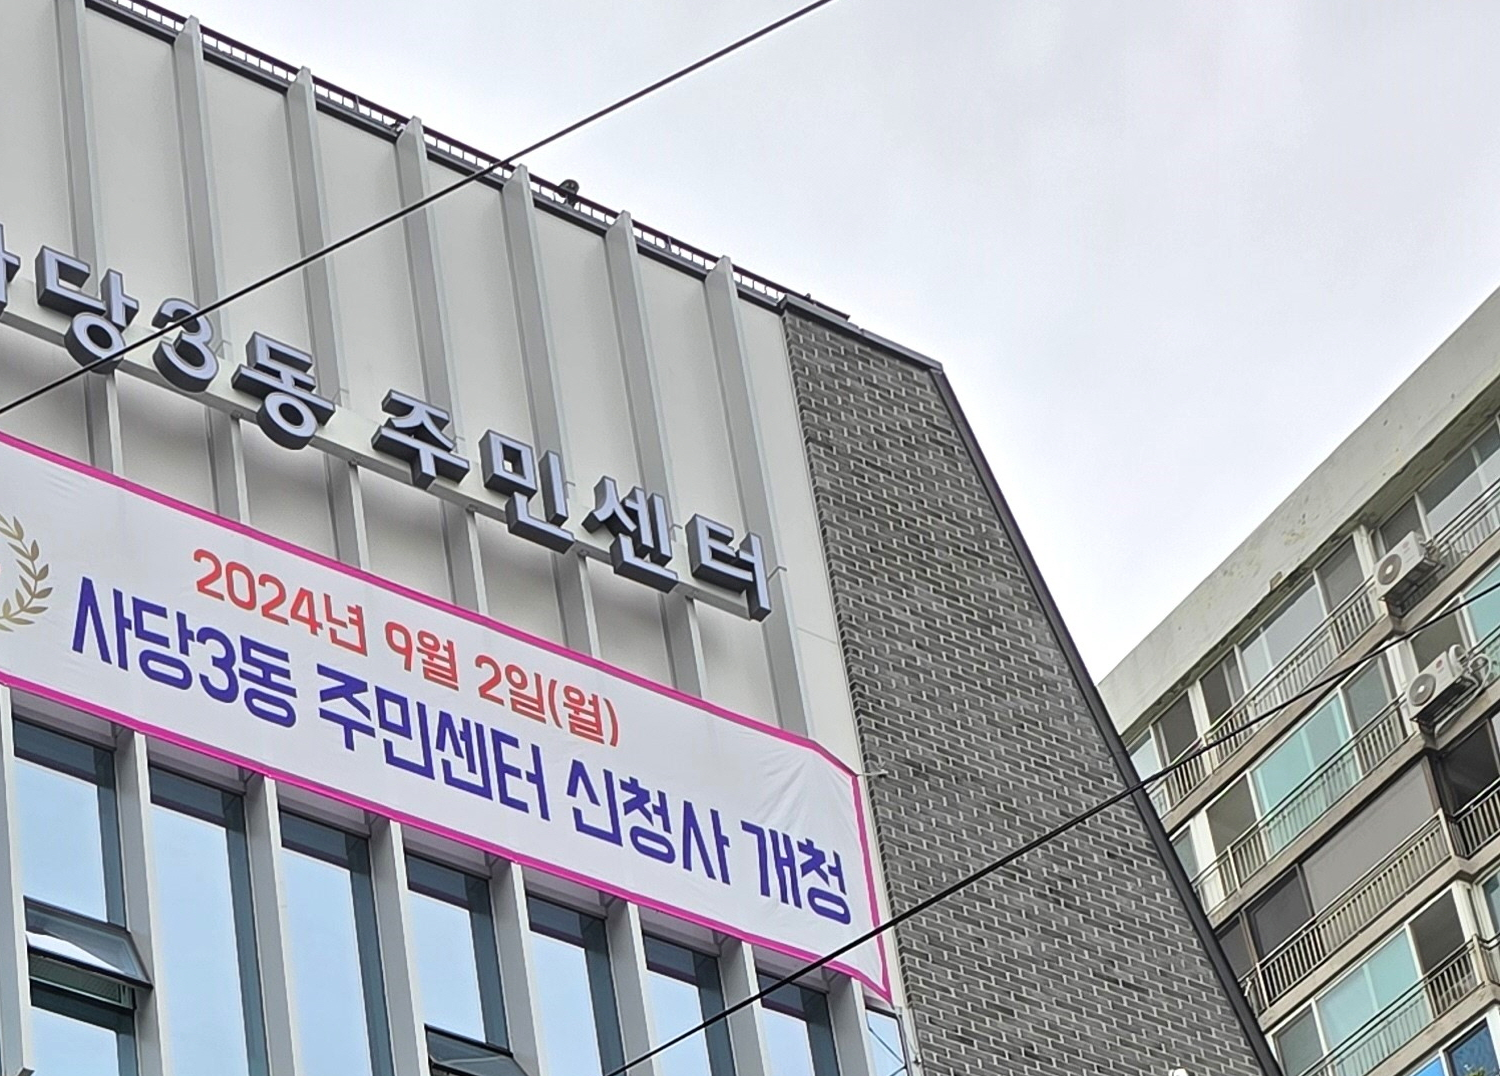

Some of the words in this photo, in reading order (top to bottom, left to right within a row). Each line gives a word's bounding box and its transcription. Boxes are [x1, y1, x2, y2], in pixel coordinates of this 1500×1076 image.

[371, 388, 773, 622] 주민센터
[71, 576, 298, 729] 사당3동
[316, 663, 551, 821] 주민센터
[566, 759, 731, 885] 신청사
[740, 820, 853, 926] 개청
[193, 549, 367, 656] 2024년
[384, 621, 460, 684] 9월
[474, 653, 620, 748] 2일(월)
